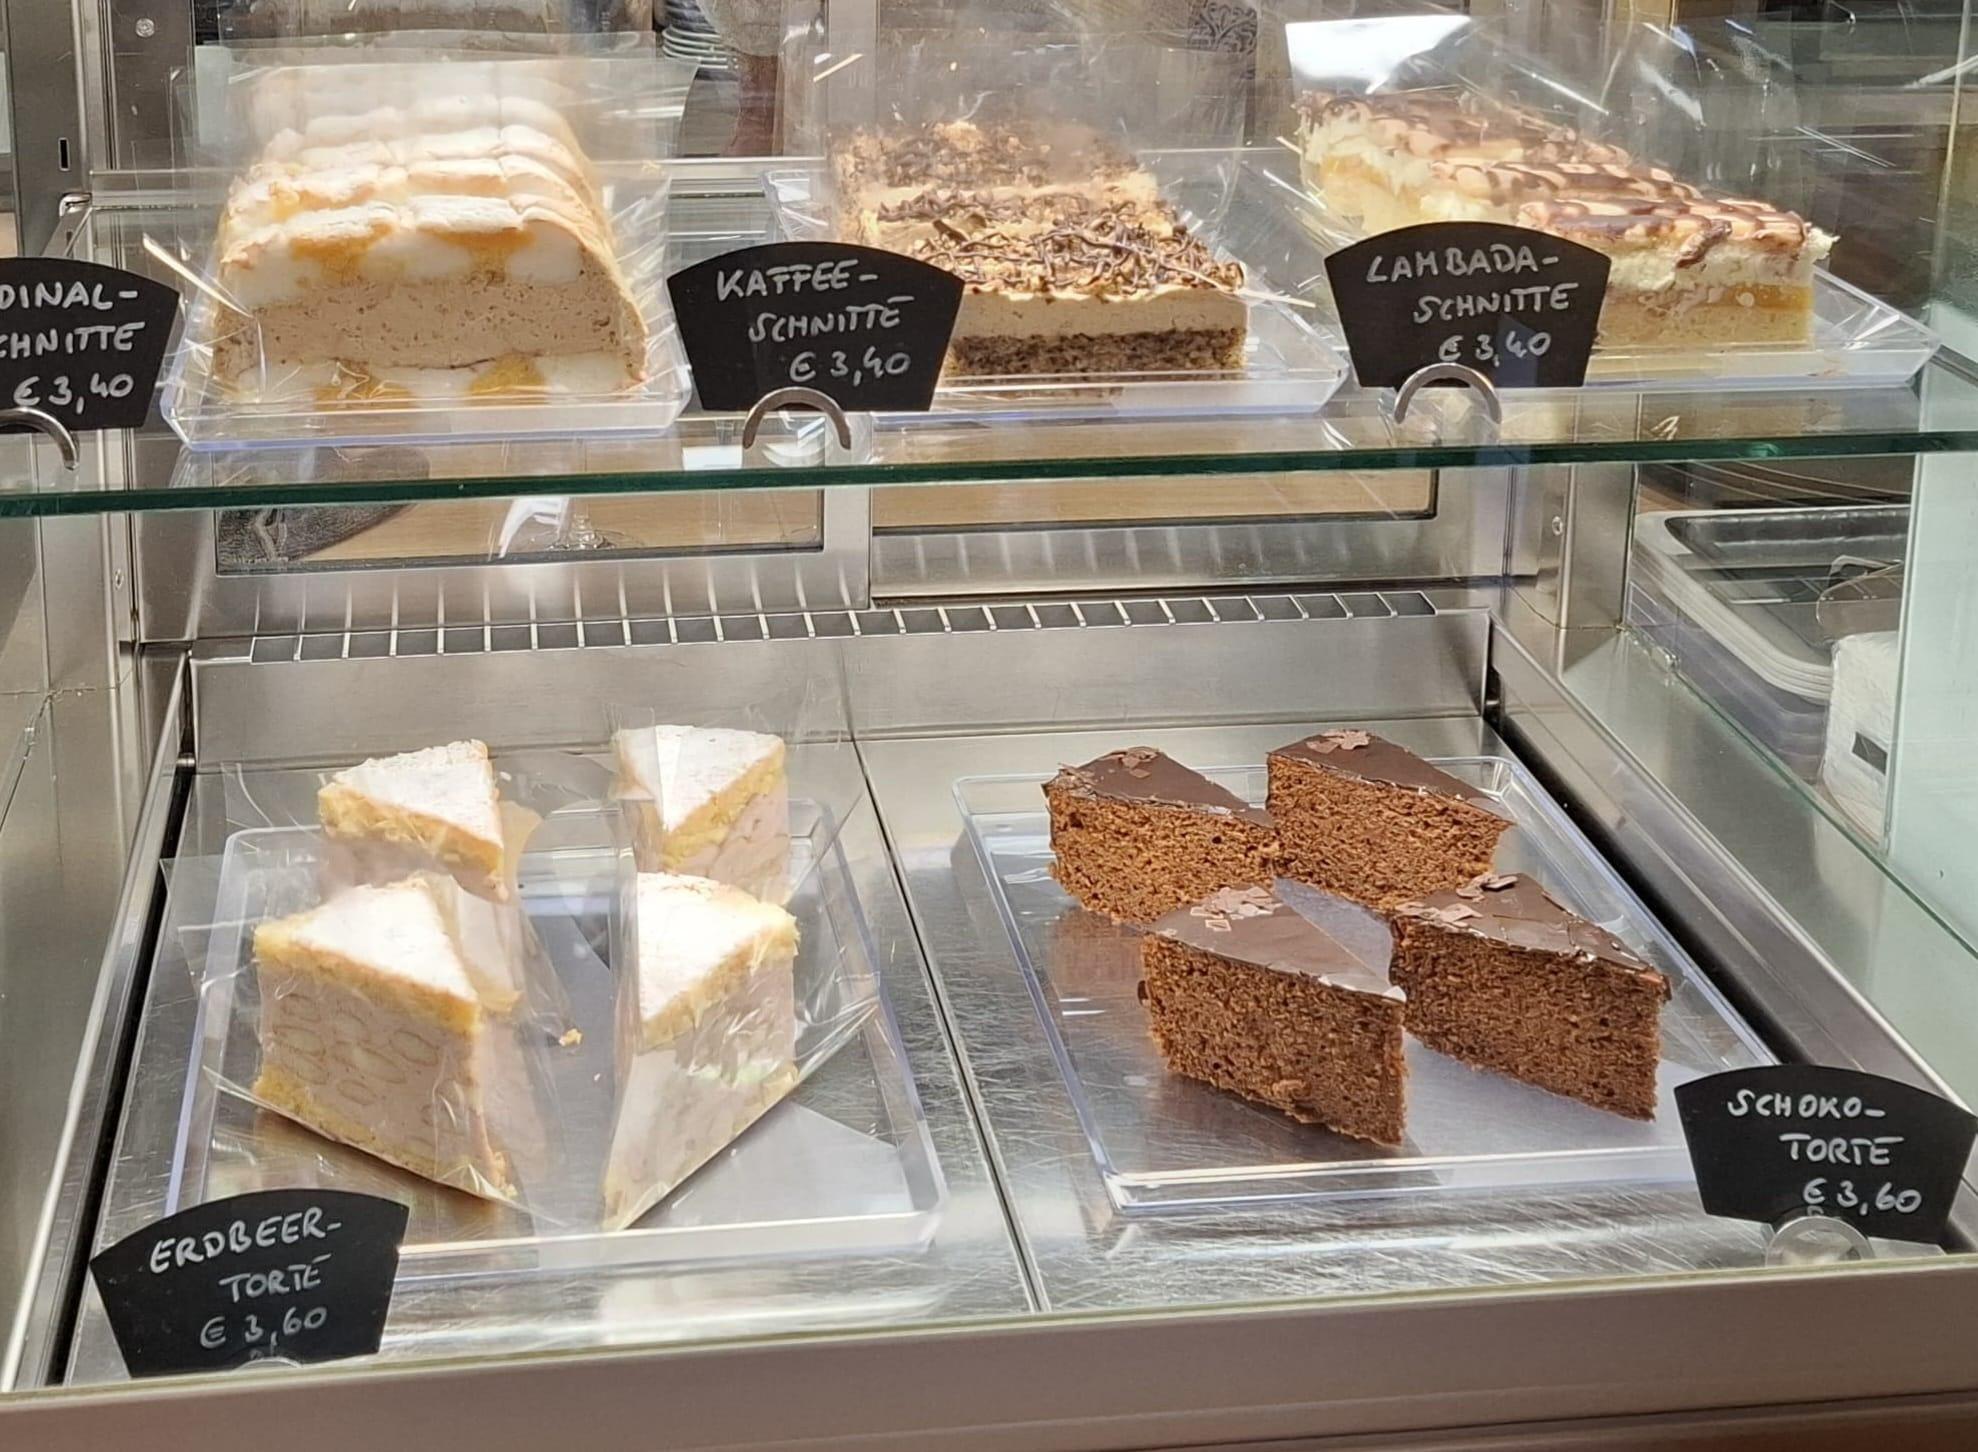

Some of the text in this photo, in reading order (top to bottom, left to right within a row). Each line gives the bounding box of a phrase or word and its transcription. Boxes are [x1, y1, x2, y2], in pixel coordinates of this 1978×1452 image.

[717, 259, 879, 301] KAFFEE-
[1366, 243, 1559, 282] LAMBADA-
[749, 296, 915, 342] SCHNITTE
[1413, 282, 1579, 324] SCHNITTE
[1728, 1089, 1886, 1119] SCHOKO-
[1779, 1133, 1905, 1166] TORTE
[150, 1206, 342, 1274] ERDBEER-
[218, 1253, 332, 1303] TORTE
